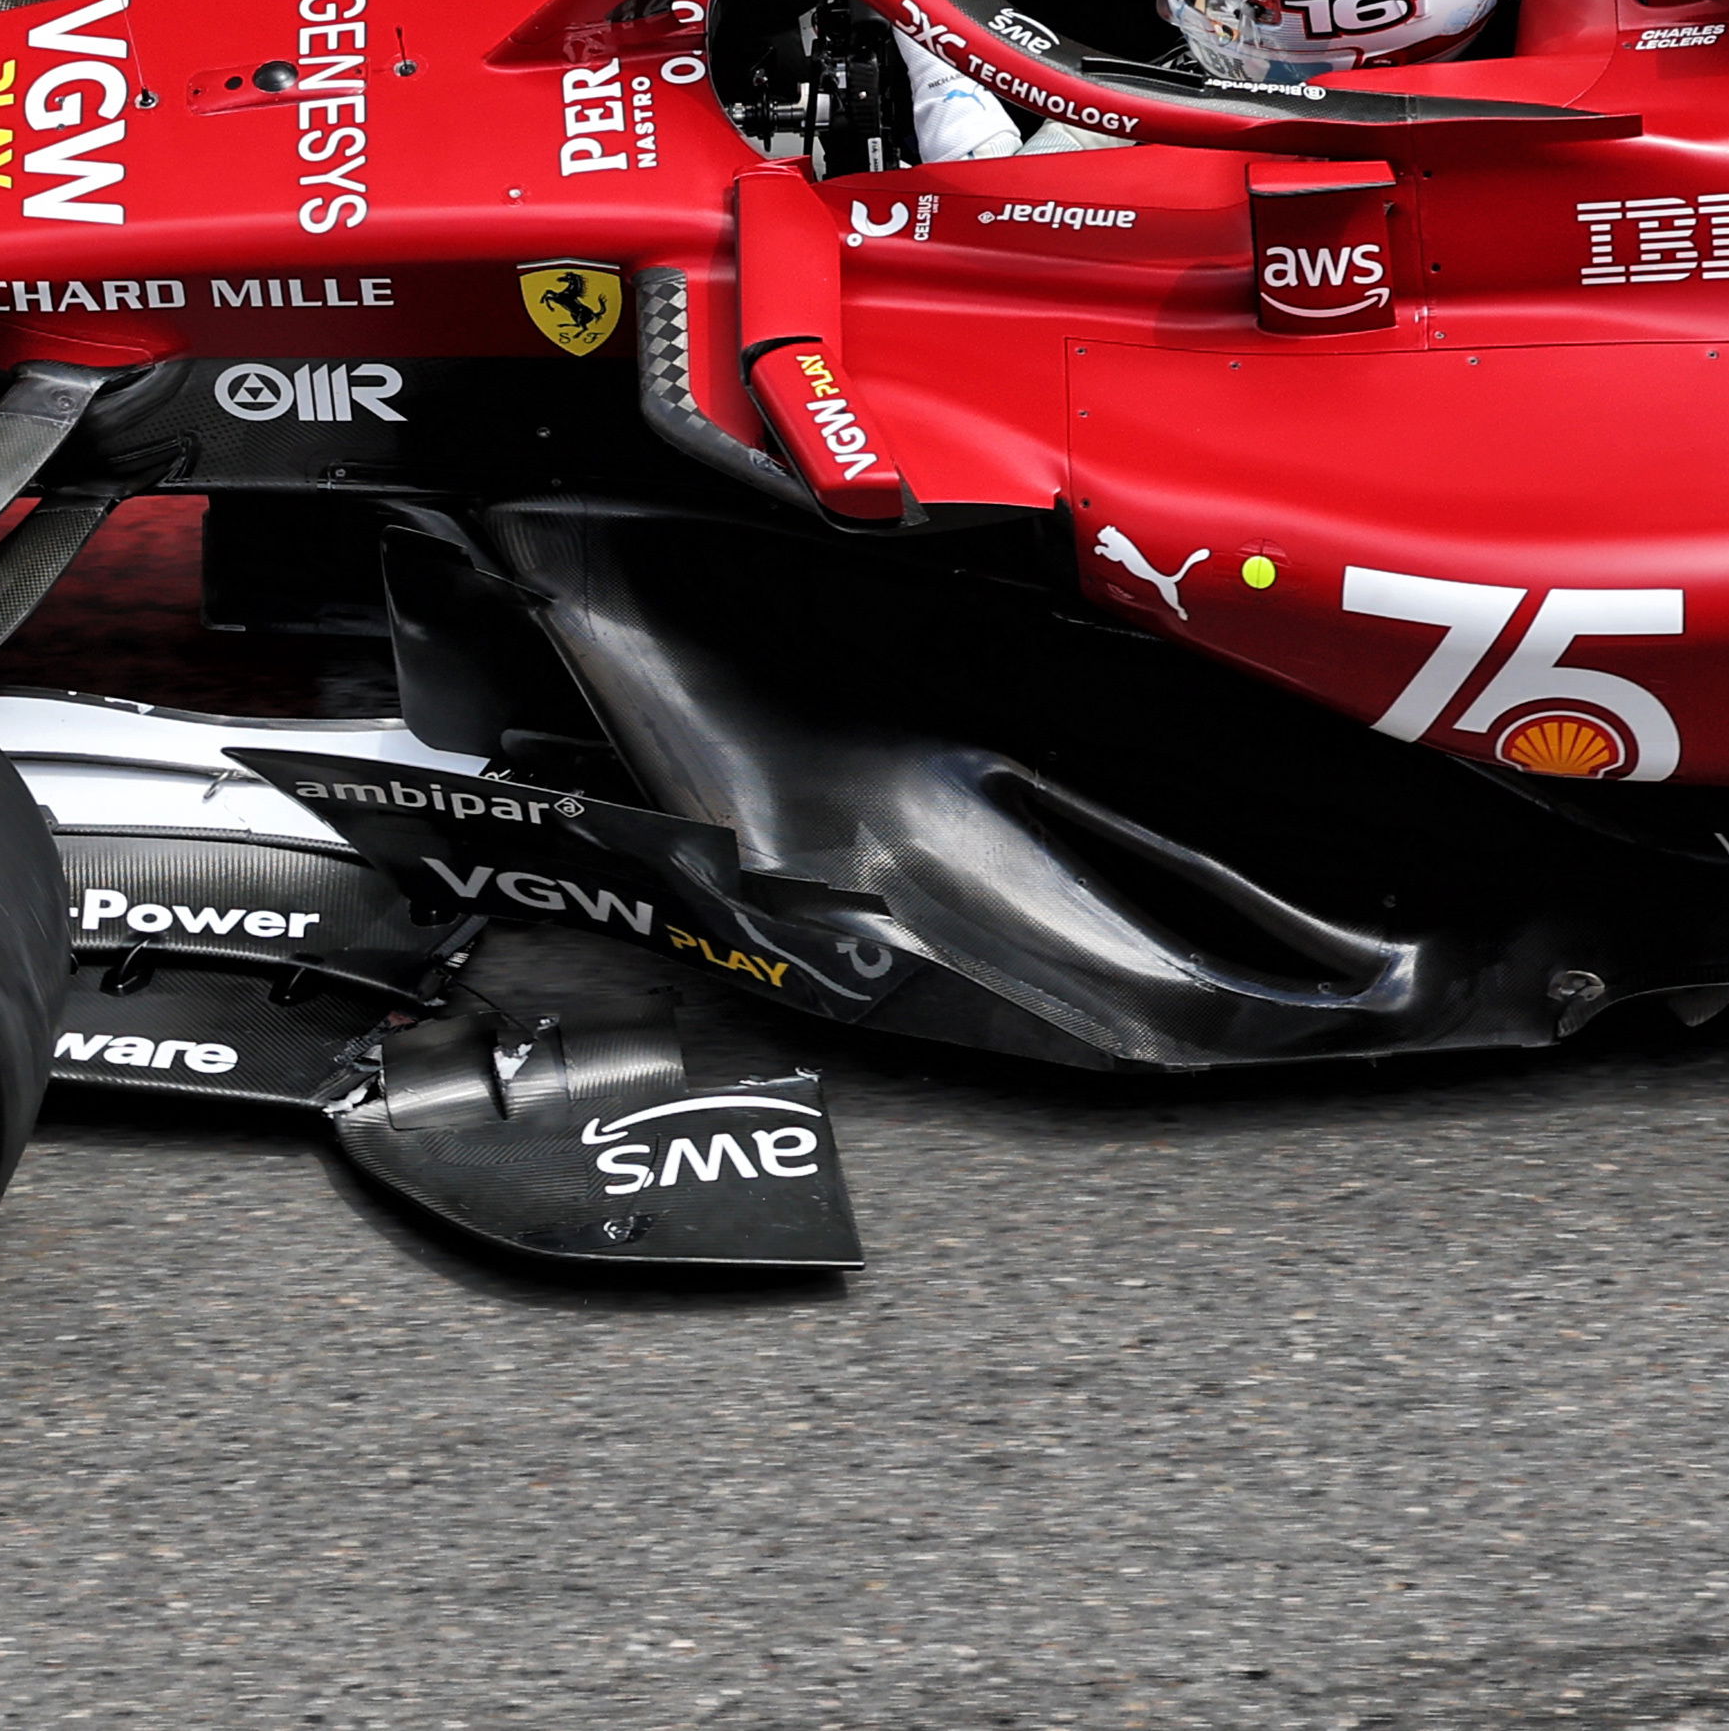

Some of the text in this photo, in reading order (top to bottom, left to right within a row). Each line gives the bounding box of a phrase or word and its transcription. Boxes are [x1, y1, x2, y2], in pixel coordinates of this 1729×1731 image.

[988, 13, 1053, 55] aws
[1635, 35, 1717, 50] LECLERC
[1641, 24, 1725, 40] CHARLES
[966, 53, 1140, 134] TECHNOLOGY
[1205, 78, 1302, 96] Bitdefender
[631, 76, 658, 168] NASTRO
[913, 194, 933, 241] CELSIUS
[997, 202, 1136, 229] ambipar
[1264, 243, 1383, 287] aws
[210, 277, 395, 308] MILLE
[796, 353, 877, 481] VGW PLAY
[1342, 565, 1684, 783] 75
[294, 780, 551, 825] ambipar
[421, 856, 654, 937] VGW
[666, 924, 790, 987] PLAY
[52, 1031, 239, 1074] ware
[595, 1125, 818, 1196] aws
